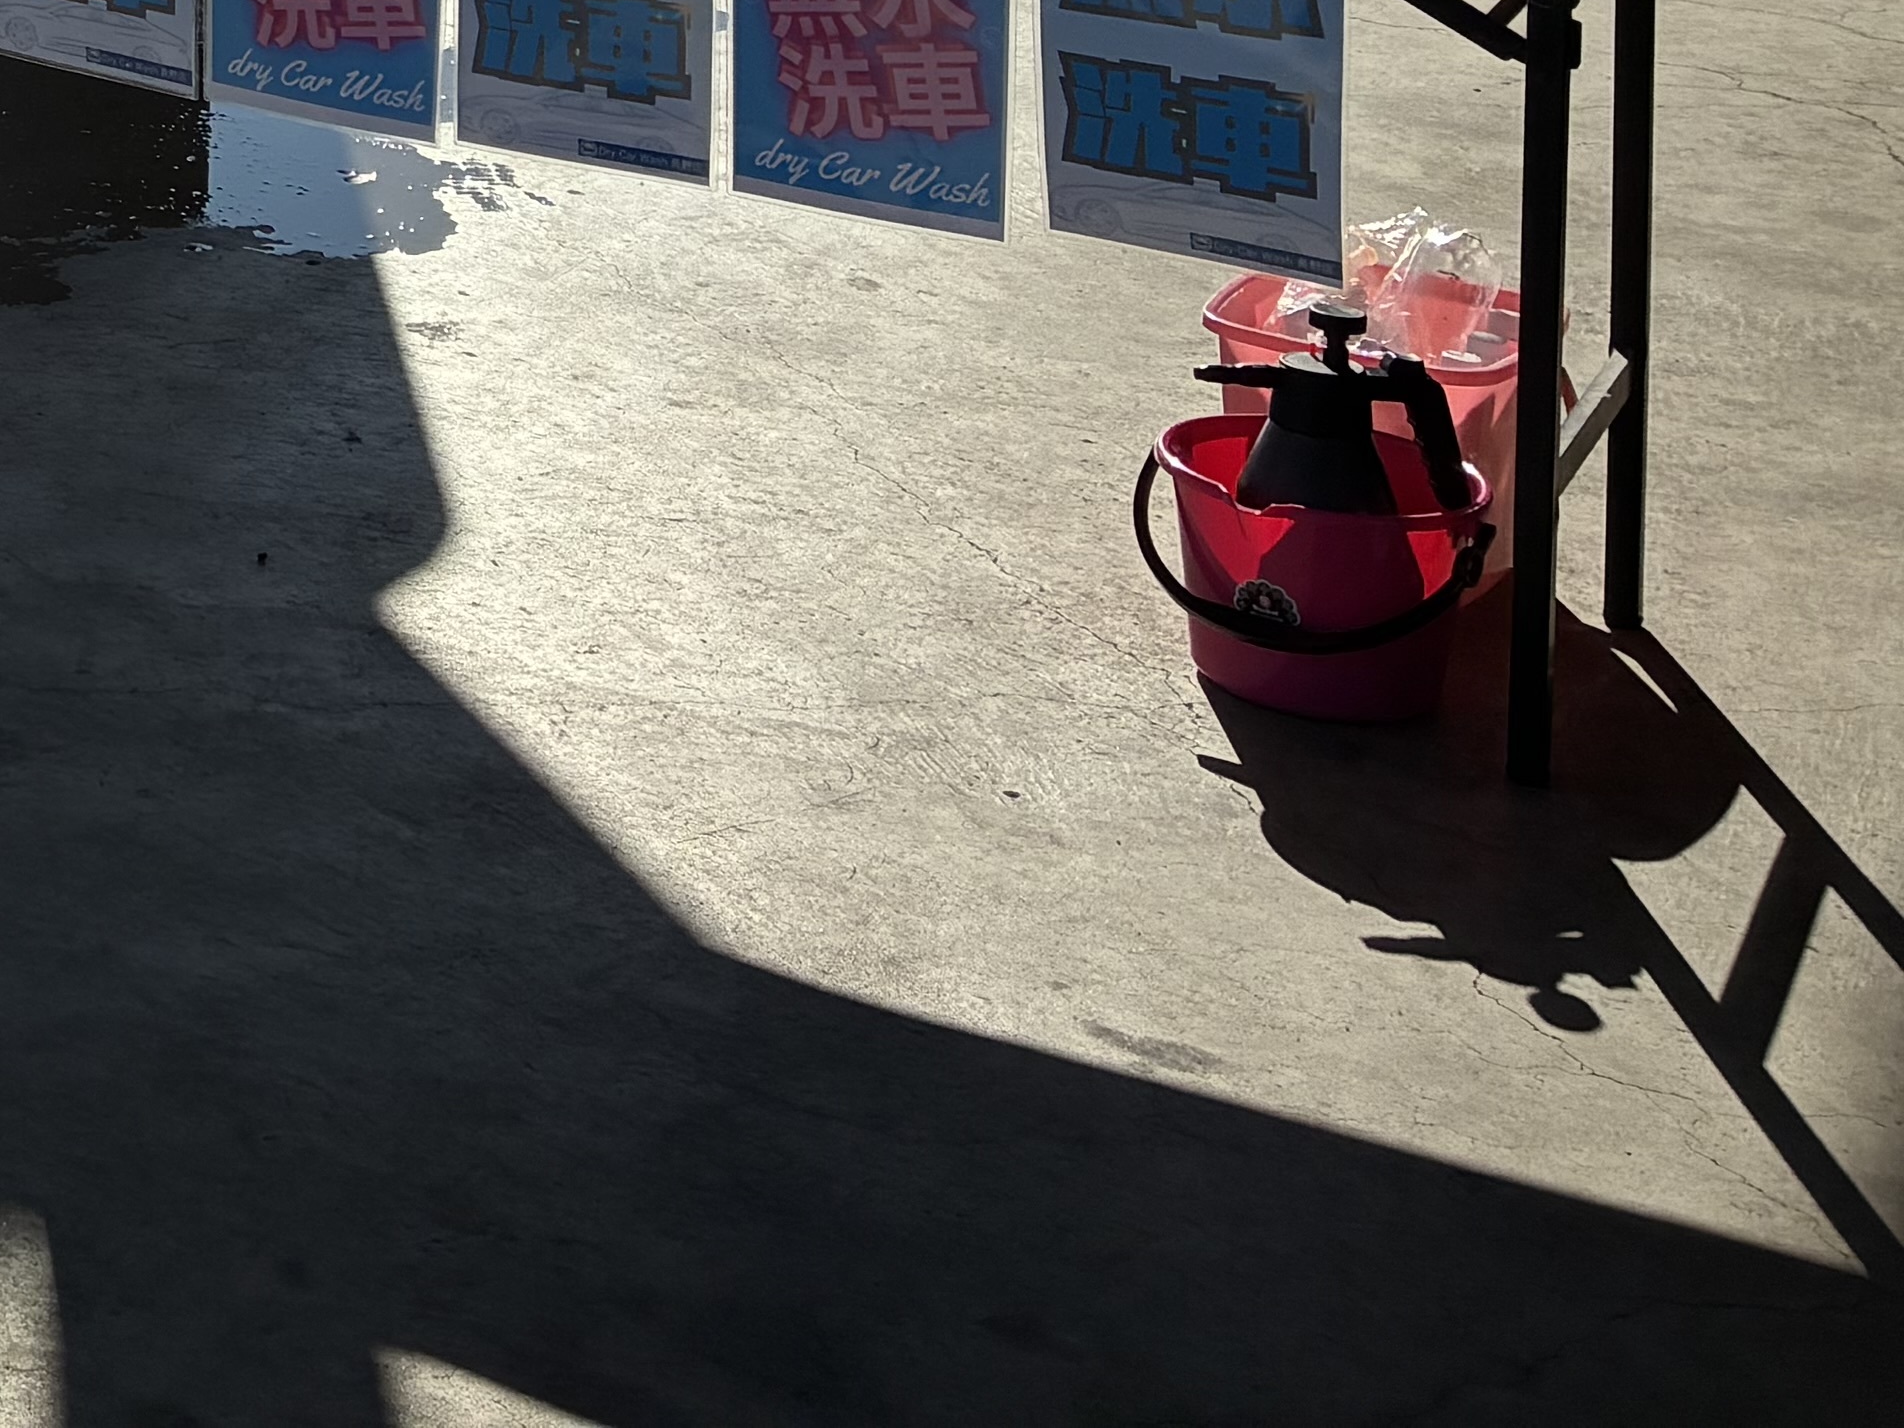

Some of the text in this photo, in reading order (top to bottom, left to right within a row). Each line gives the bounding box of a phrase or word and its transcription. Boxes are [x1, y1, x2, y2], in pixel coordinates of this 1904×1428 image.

[227, 47, 274, 91] dry
[280, 59, 333, 91] Car
[340, 68, 426, 113] Wash
[777, 43, 992, 142] 洗車
[1058, 50, 1318, 203] 洗車
[754, 138, 992, 209] dry Car Wash
